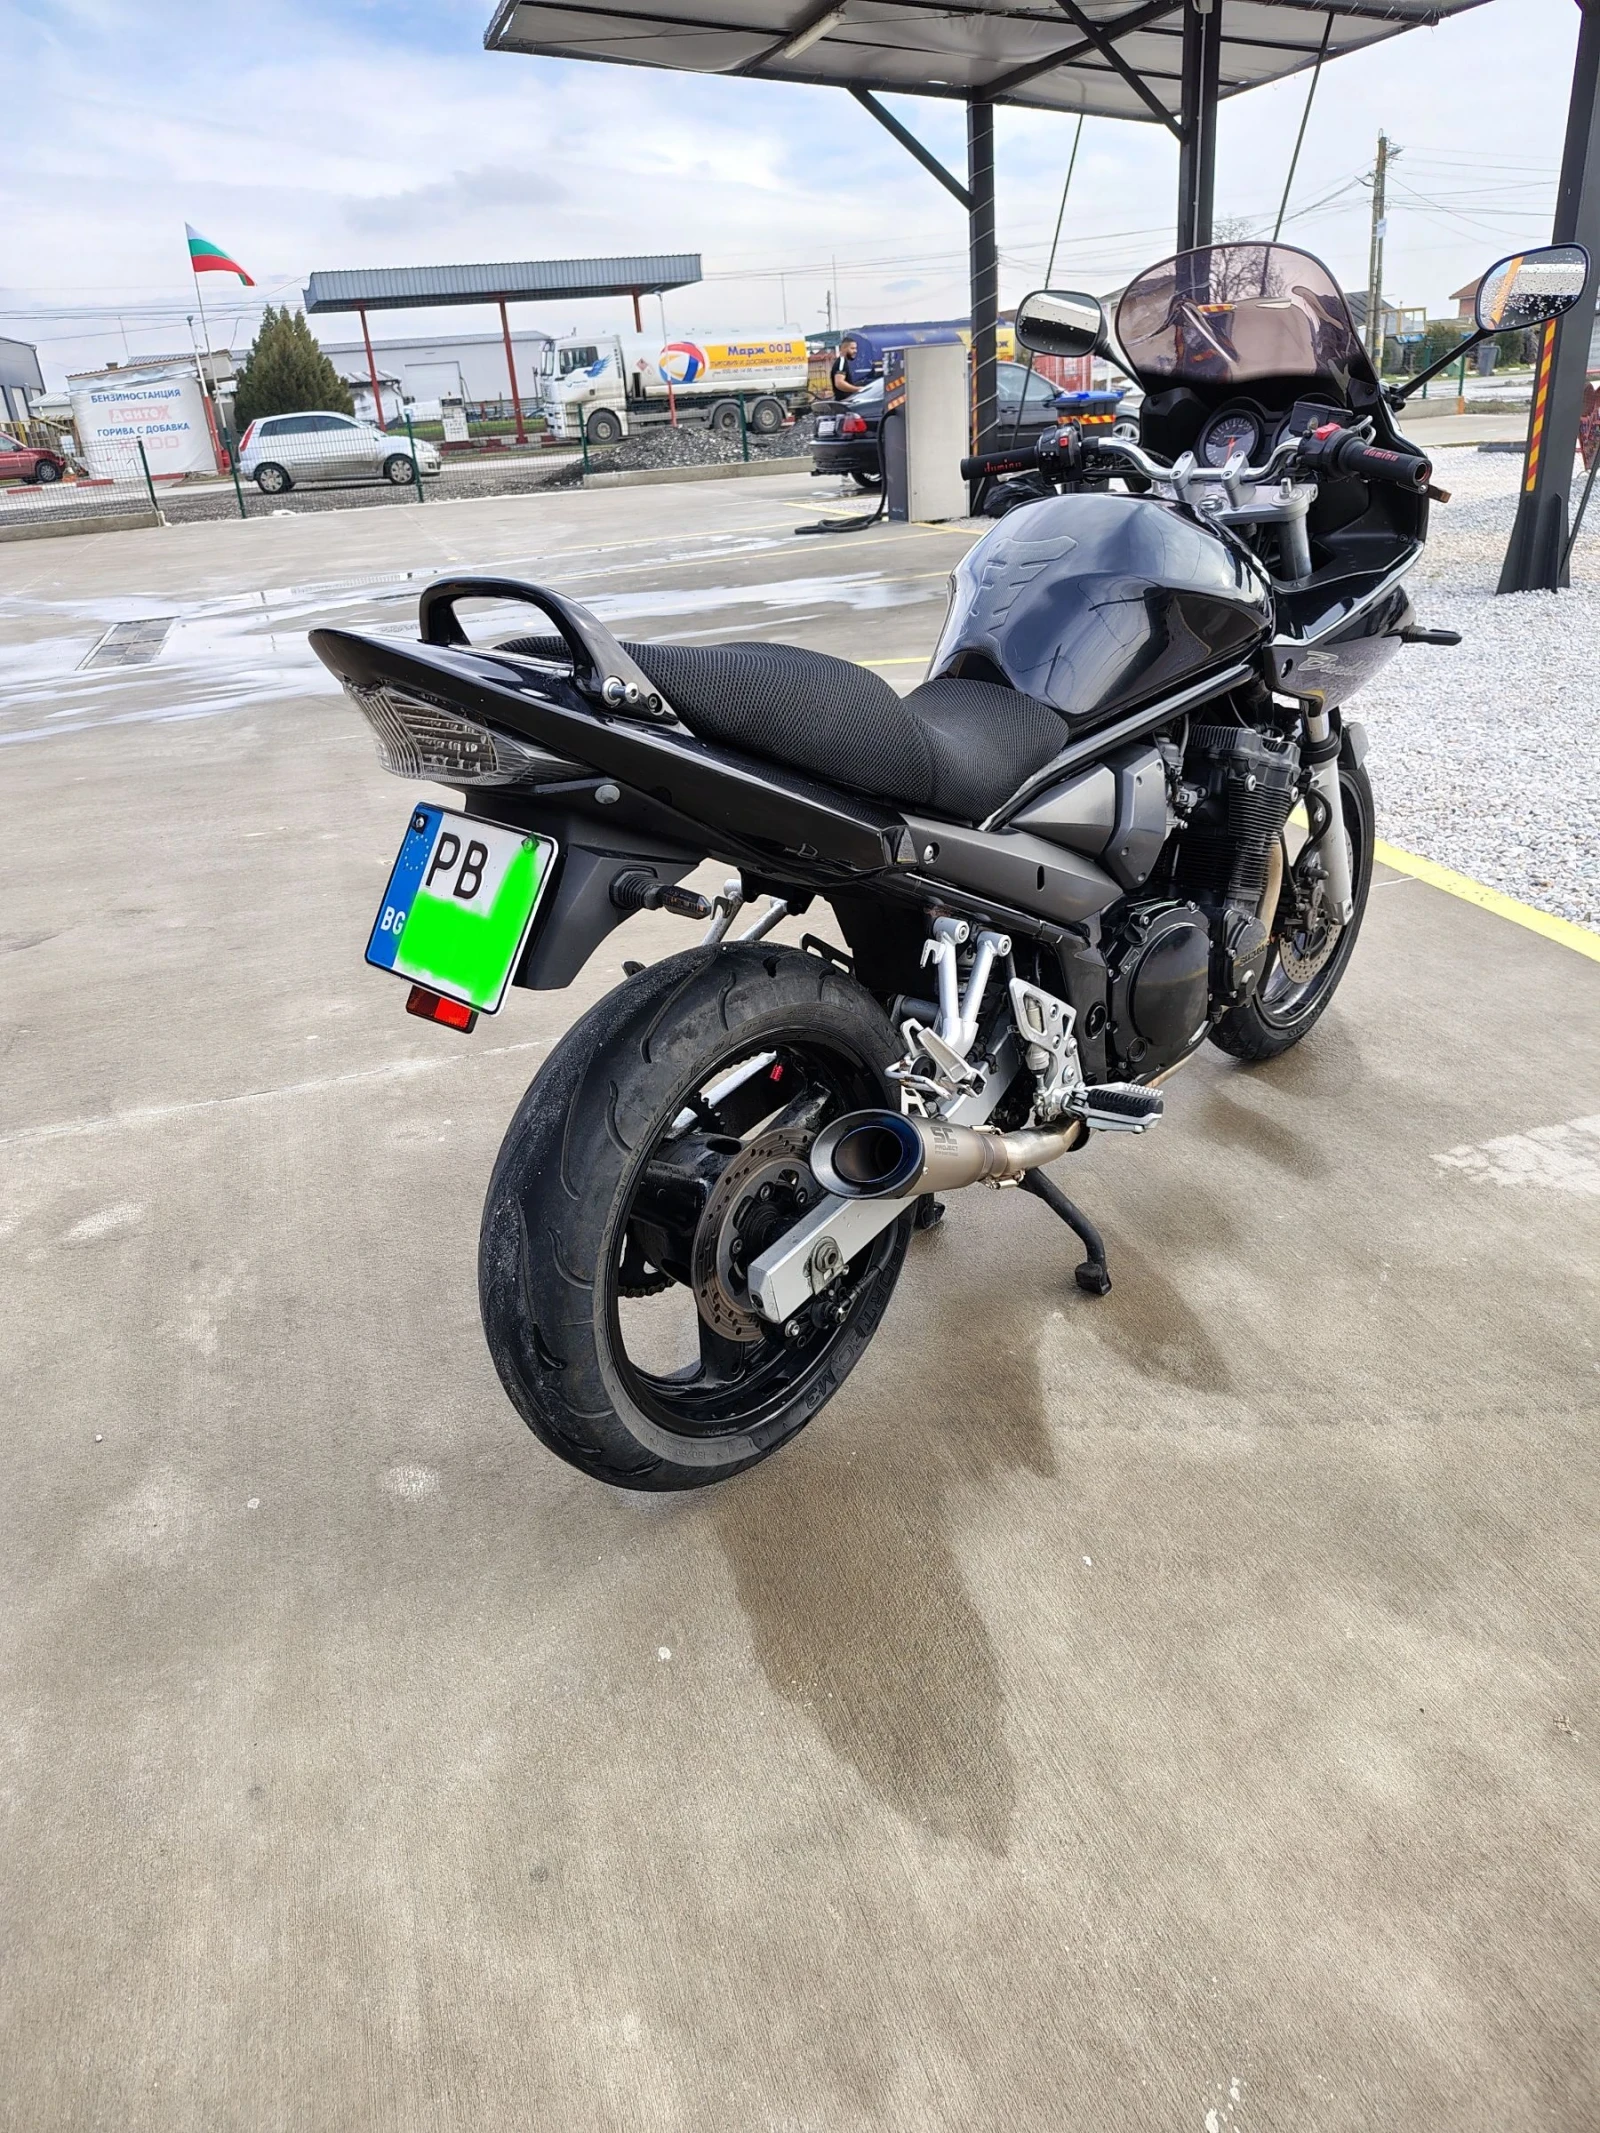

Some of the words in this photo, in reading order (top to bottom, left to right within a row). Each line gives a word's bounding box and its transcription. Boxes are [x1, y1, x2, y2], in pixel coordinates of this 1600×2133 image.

[728, 346, 765, 357] Марж
[769, 343, 792, 354] ООД
[91, 389, 181, 404] БЕНЗИНОСТАНЦИЯ
[97, 426, 135, 437] ГОРИВА
[137, 426, 144, 434] С
[146, 422, 190, 434] ДОБАВКА
[425, 831, 489, 900] PB
[380, 906, 406, 935] BG
[930, 1126, 957, 1144] SC
[934, 1144, 958, 1152] PROJECT
